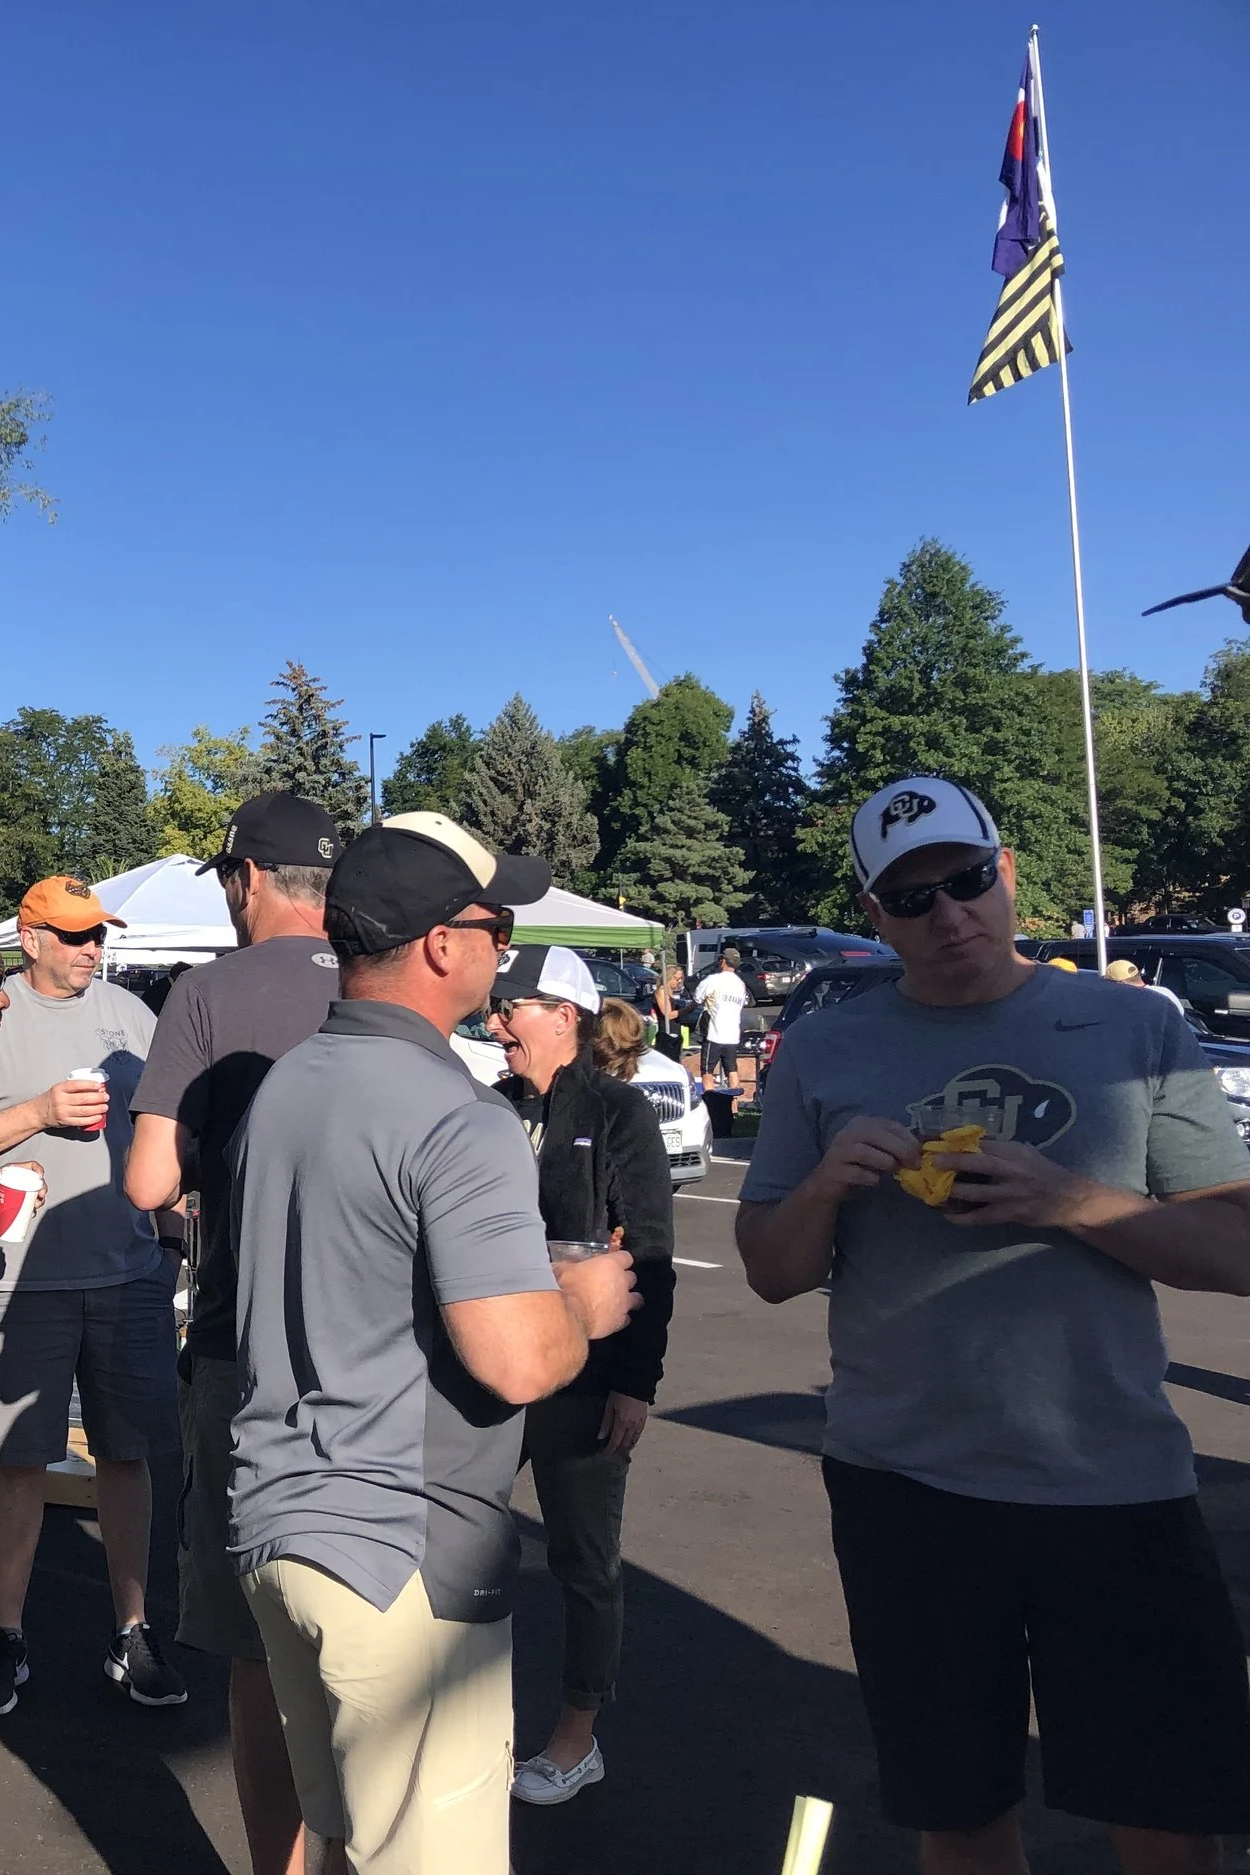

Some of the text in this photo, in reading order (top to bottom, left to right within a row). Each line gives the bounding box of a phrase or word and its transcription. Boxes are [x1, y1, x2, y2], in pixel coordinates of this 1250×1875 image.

[890, 795, 920, 817] CU
[226, 825, 238, 854] BUFFS
[318, 838, 334, 858] CU
[100, 1028, 126, 1036] STONE
[473, 1588, 501, 1597] DRI-FIT
